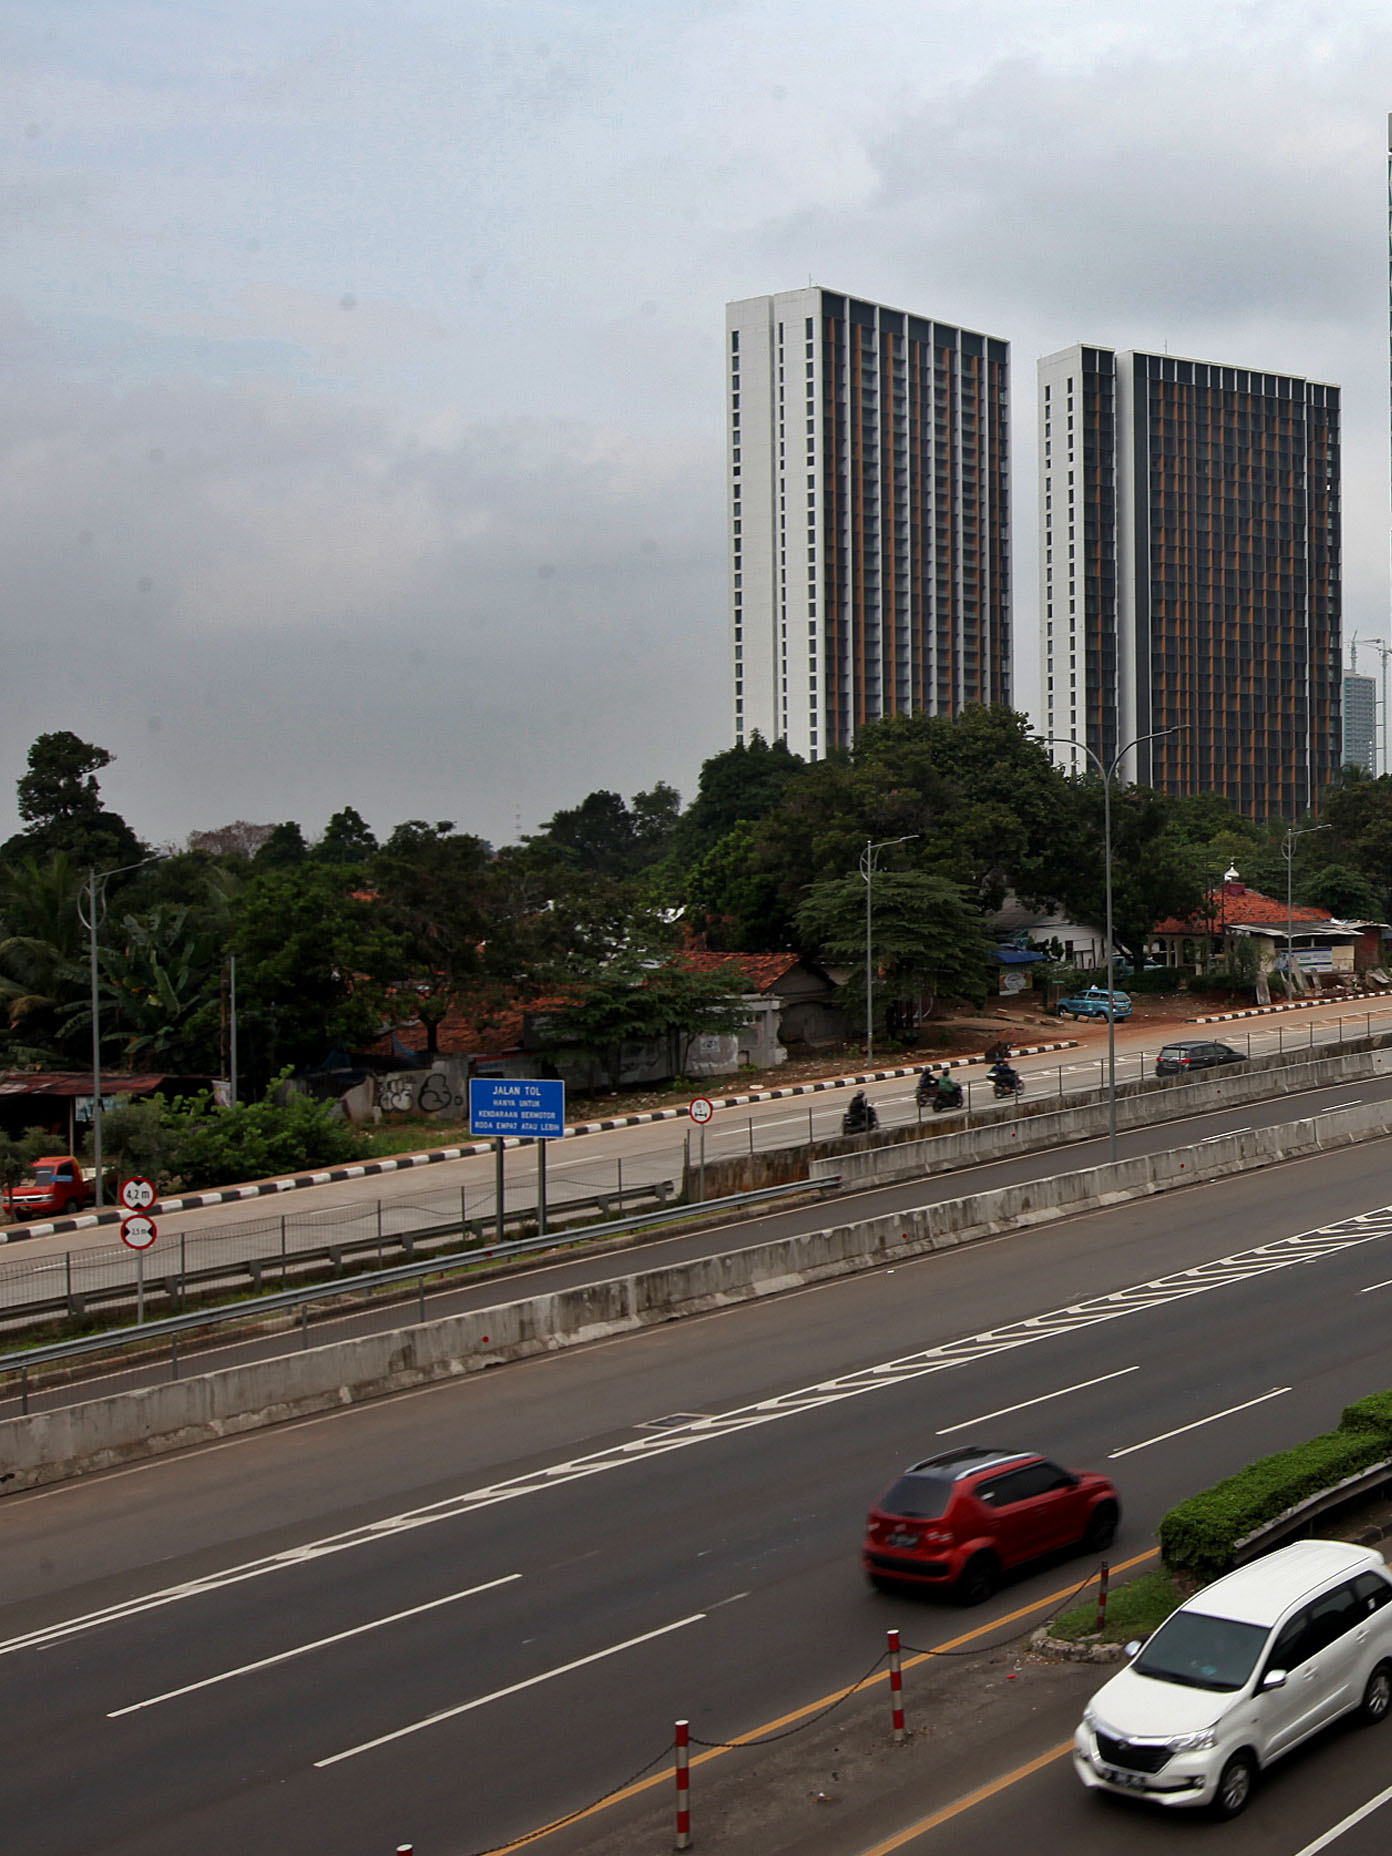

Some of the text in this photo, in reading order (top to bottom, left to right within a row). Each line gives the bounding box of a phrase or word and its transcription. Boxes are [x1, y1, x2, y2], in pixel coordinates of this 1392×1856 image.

[492, 1086, 541, 1096] JALAN TOL
[478, 1110, 556, 1119] KENDARAAN BERMOTOR
[496, 1122, 517, 1130] EMPAT
[126, 1189, 150, 1200] 4,2 m
